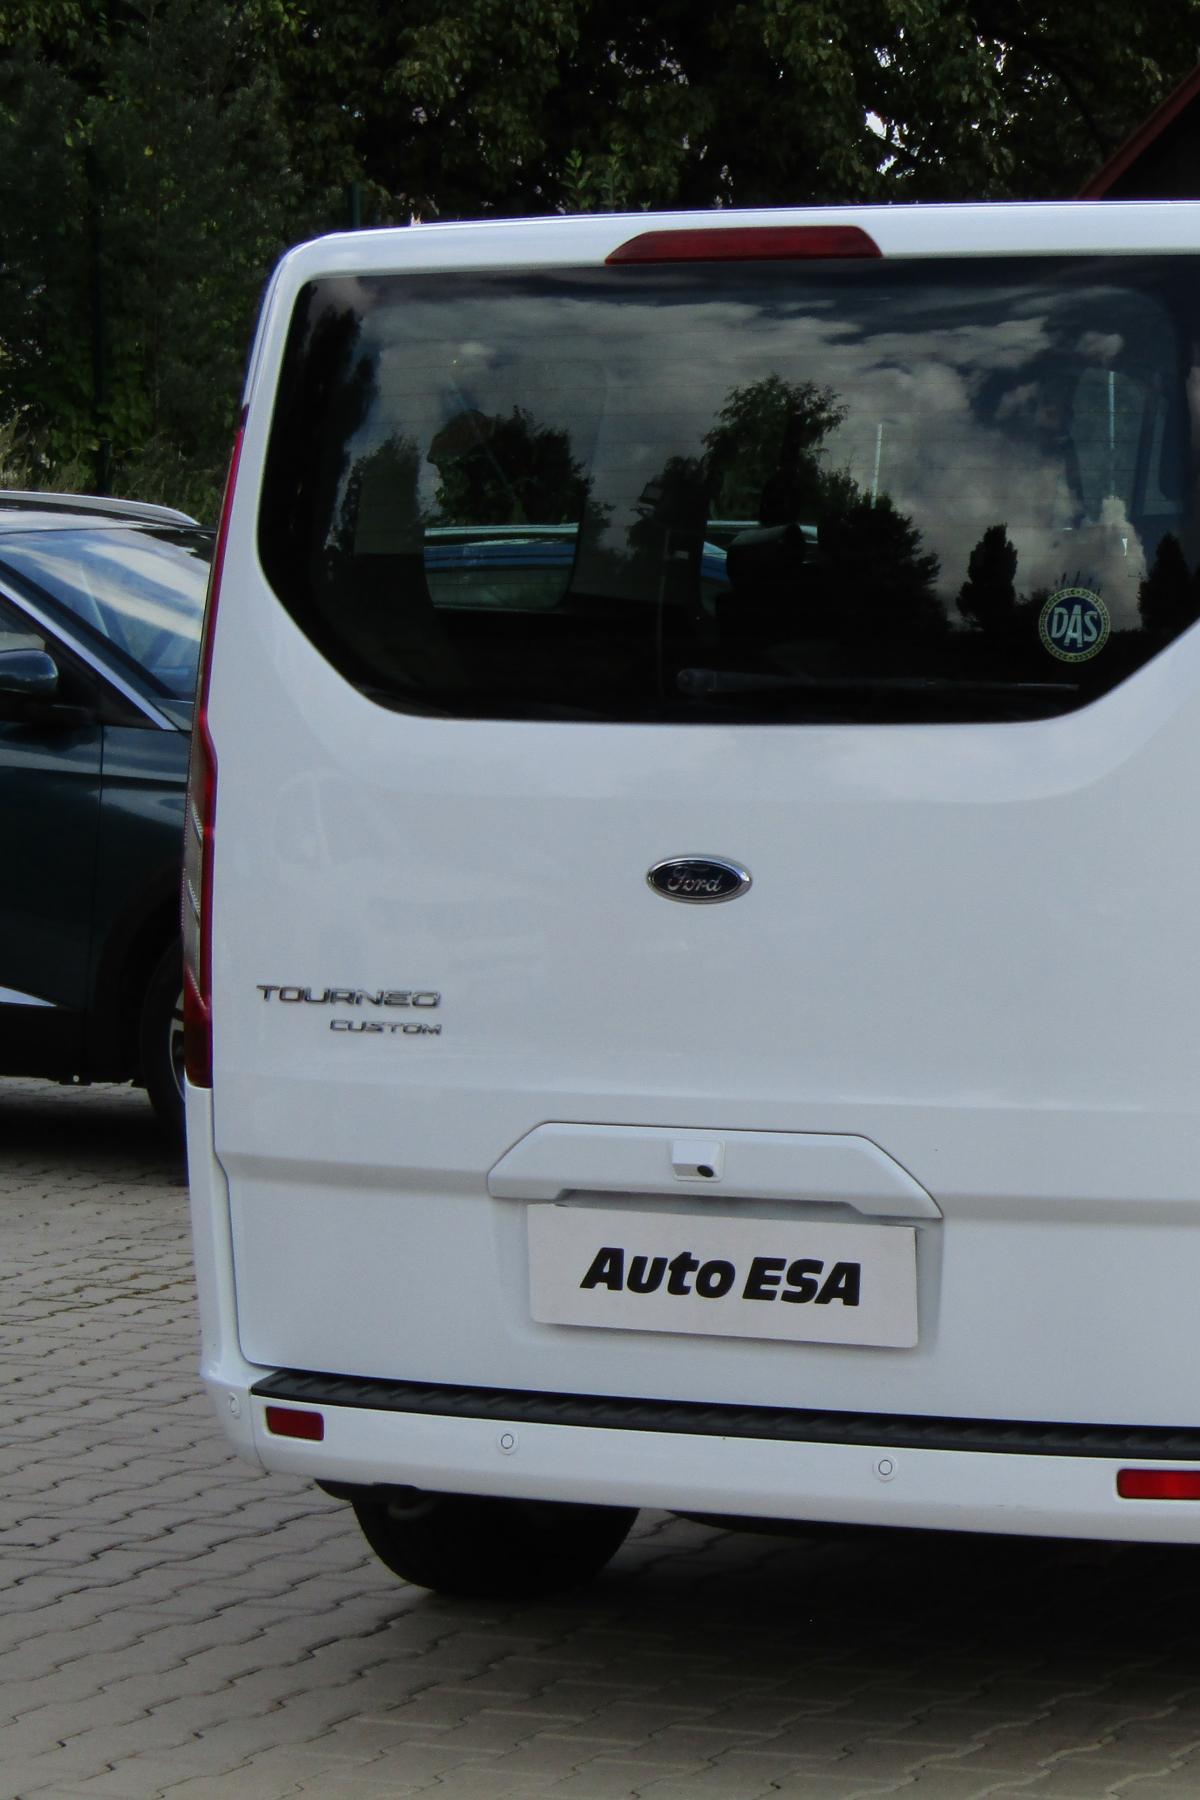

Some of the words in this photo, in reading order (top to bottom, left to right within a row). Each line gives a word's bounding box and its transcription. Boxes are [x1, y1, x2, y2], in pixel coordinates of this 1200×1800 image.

[1051, 604, 1098, 648] DAS
[667, 865, 722, 892] Ford
[256, 985, 441, 1008] TOURNEO
[330, 1019, 442, 1035] CUSTOM
[579, 1247, 736, 1298] Auto
[742, 1256, 861, 1306] ESA
